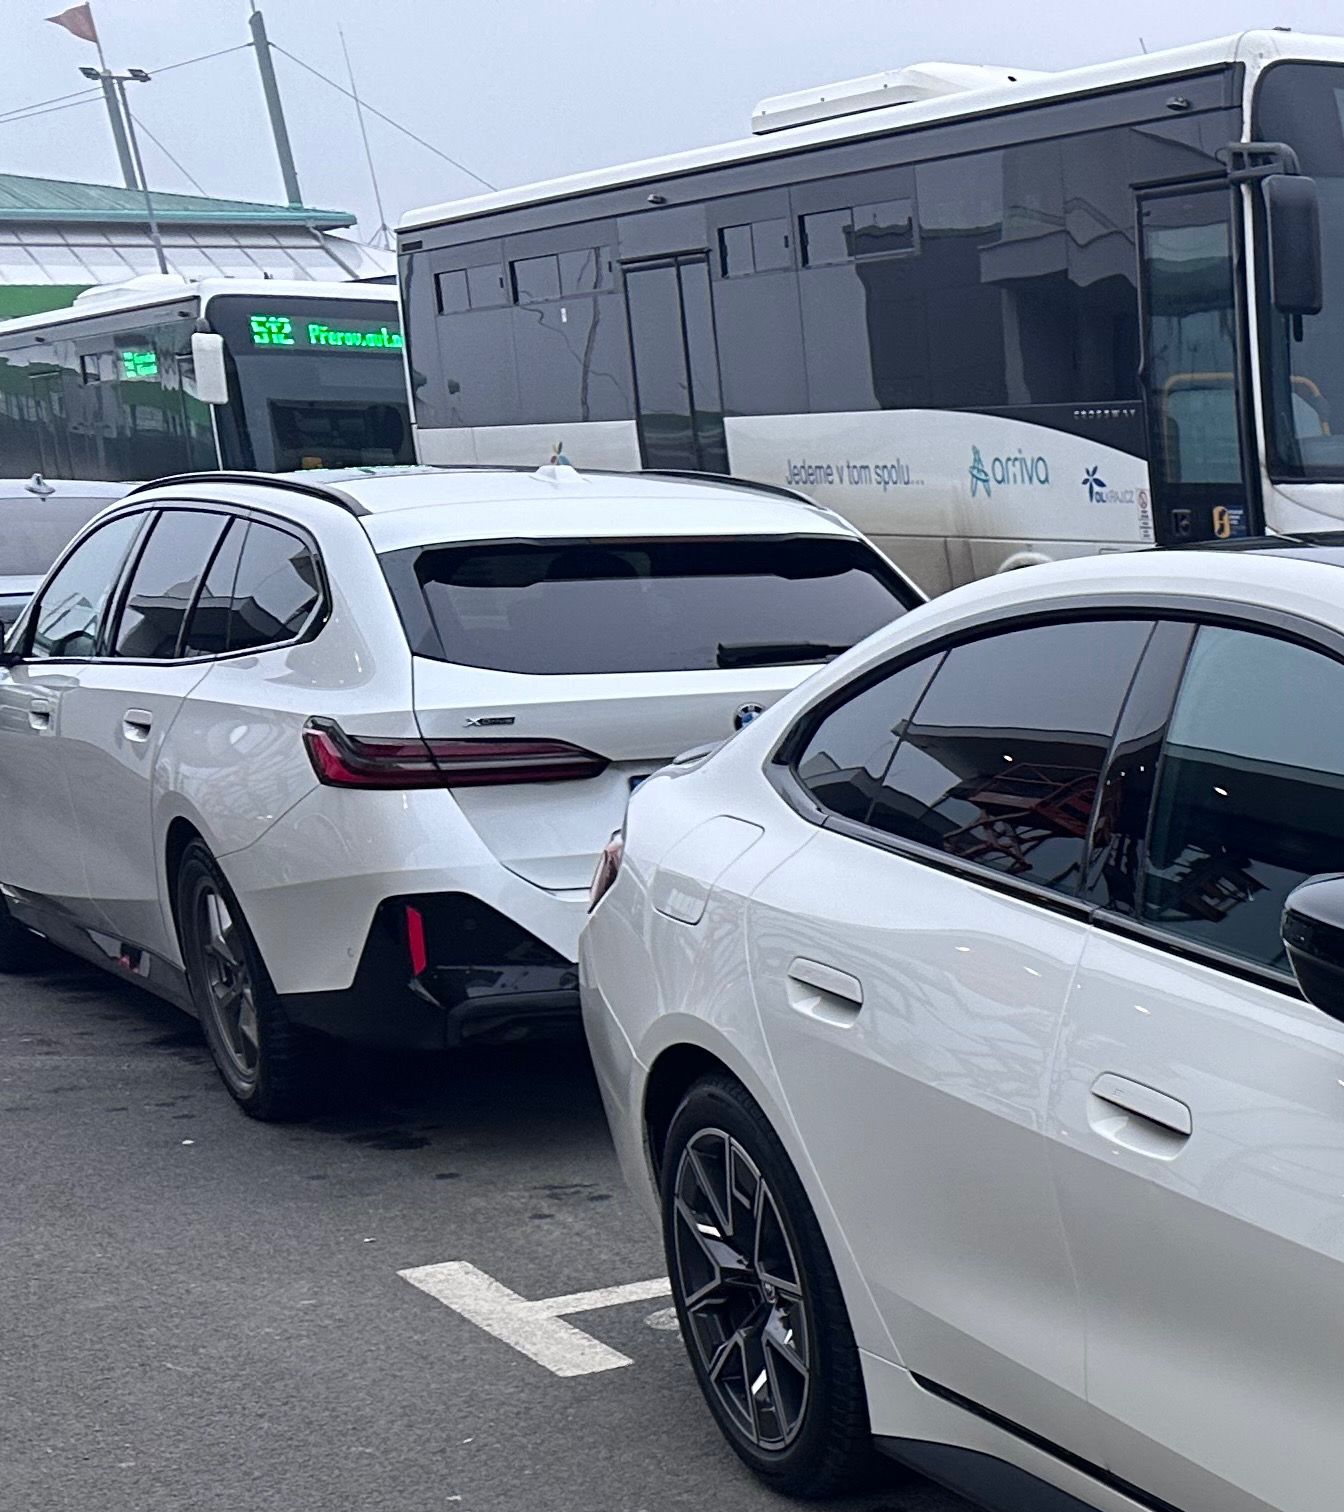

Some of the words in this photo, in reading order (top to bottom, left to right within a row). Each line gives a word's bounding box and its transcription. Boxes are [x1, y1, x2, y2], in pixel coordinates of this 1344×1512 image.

[786, 459, 834, 485] Jedeme
[836, 464, 844, 484] v
[846, 459, 872, 485] tom
[991, 448, 1050, 486] arriva
